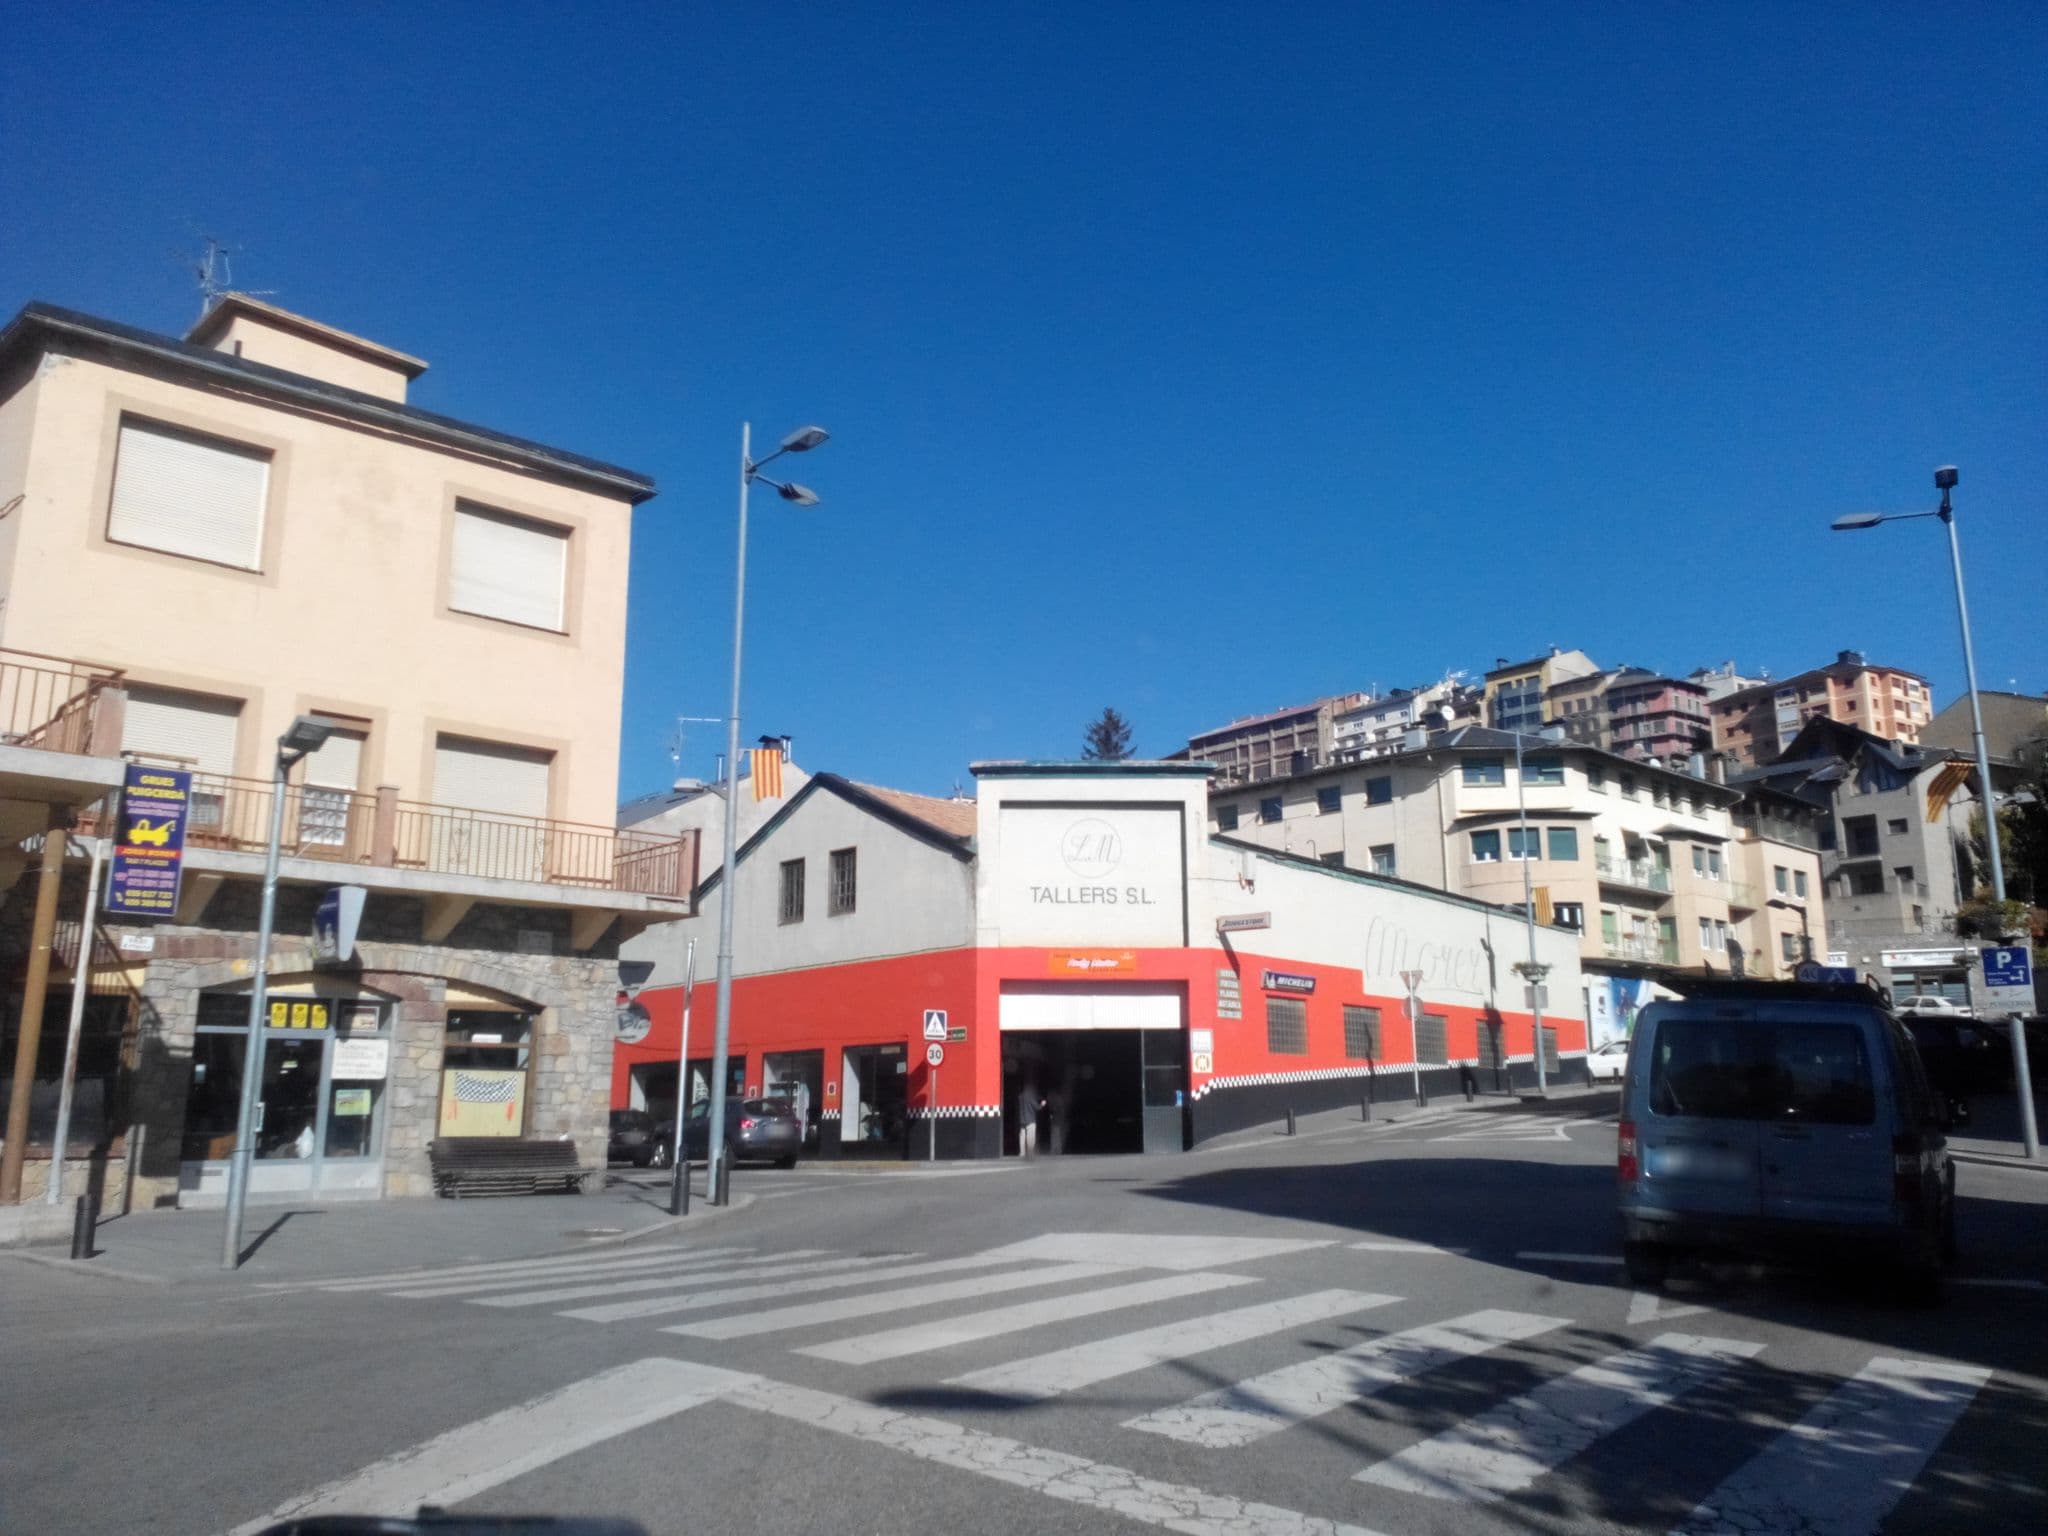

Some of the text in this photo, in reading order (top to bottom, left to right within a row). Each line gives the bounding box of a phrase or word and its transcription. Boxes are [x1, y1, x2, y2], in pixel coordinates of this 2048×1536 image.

[140, 775, 175, 787] GRUES
[1030, 886, 1118, 904] TALLERS
[1996, 951, 2012, 969] P
[1277, 975, 1314, 989] MICHELIN
[928, 1049, 942, 1060] 30
